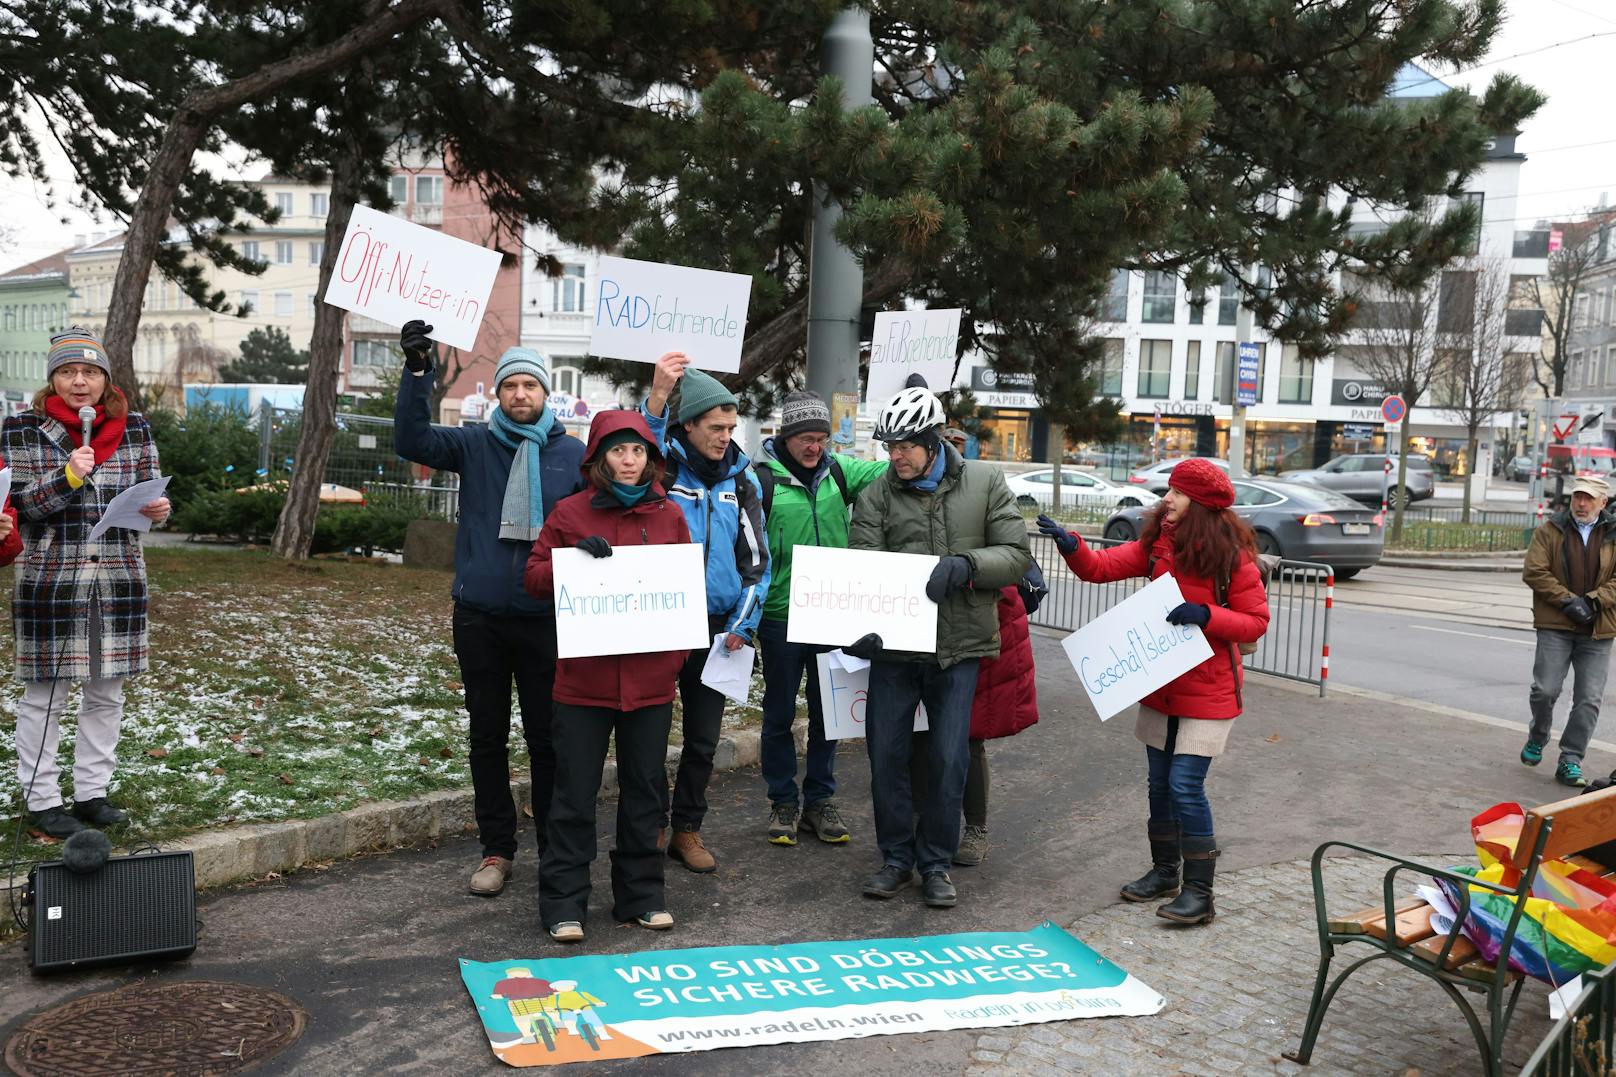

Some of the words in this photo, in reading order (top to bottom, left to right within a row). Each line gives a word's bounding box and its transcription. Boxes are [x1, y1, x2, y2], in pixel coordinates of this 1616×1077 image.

[597, 279, 738, 338] RADfahrende
[989, 395, 1026, 405] PAPIER
[1154, 401, 1213, 416] STÖGER
[556, 580, 686, 618] Anrainer:innen
[793, 575, 920, 617] Gehbehinderte
[614, 963, 697, 984] WO
[709, 956, 821, 977] SIND
[830, 943, 1049, 969] DÖBLINGS
[633, 977, 835, 1007] SICHERE
[841, 961, 1078, 993] RADWEGE?
[658, 1011, 924, 1043] www.radeln.wien
